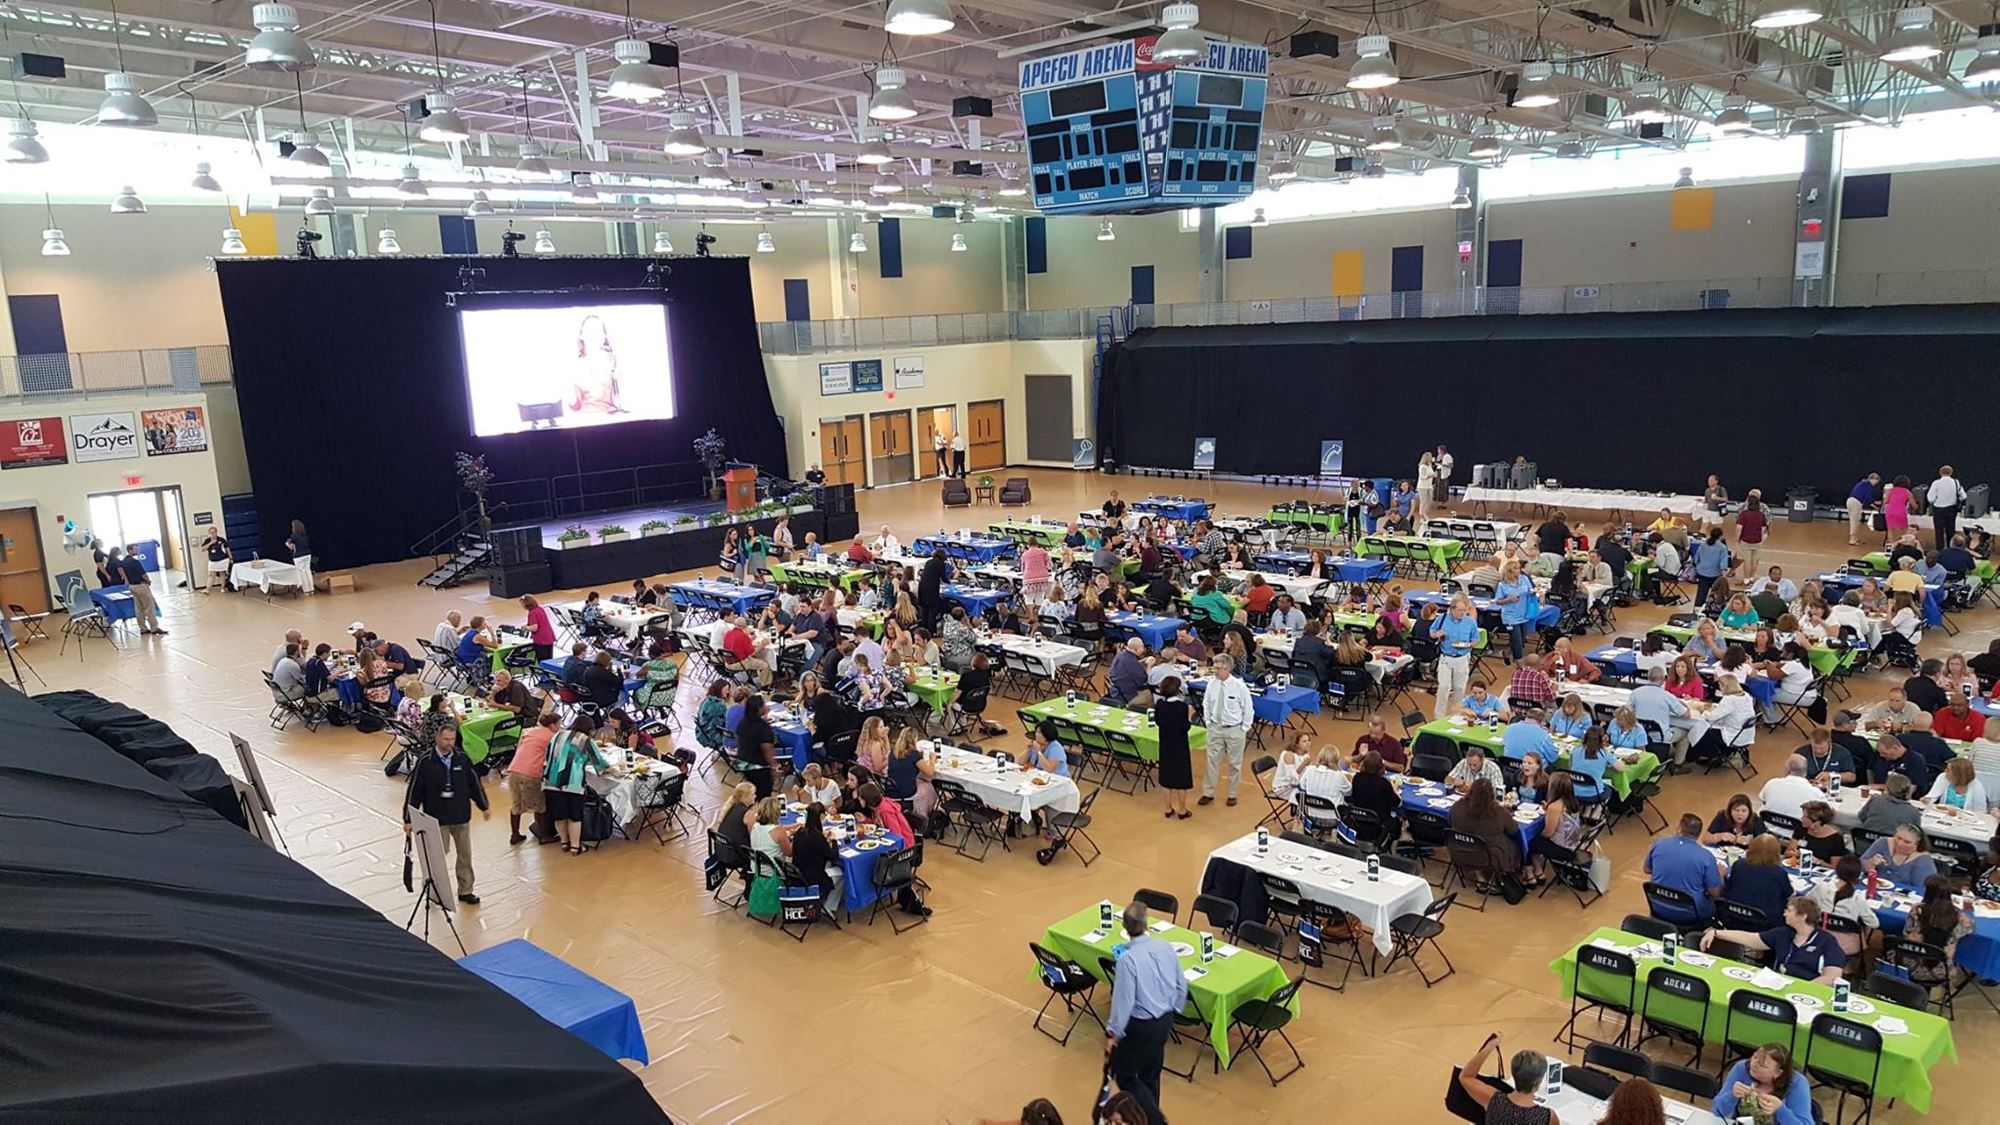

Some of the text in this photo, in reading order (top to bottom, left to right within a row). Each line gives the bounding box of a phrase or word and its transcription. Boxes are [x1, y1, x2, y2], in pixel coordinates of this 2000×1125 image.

[1229, 46, 1267, 73] ARENA
[1021, 42, 1133, 89] APGFCU ARENA
[1070, 122, 1091, 133] PERIOD
[1121, 152, 1141, 162] FOULS
[1169, 151, 1185, 159] FOULS
[1198, 152, 1216, 160] PLAYER
[1033, 165, 1050, 174] FOULS
[1066, 158, 1104, 170] PLAYER FOUL
[1079, 191, 1099, 201] MATCH
[1125, 186, 1144, 196] SCORE
[1037, 196, 1055, 206] SCORE
[75, 433, 135, 451] Drayer
[1591, 954, 1619, 969] ARENA
[1663, 977, 1692, 992] ARENA
[1747, 1000, 1780, 1016] ARENA
[1830, 1024, 1862, 1041] ARENA
